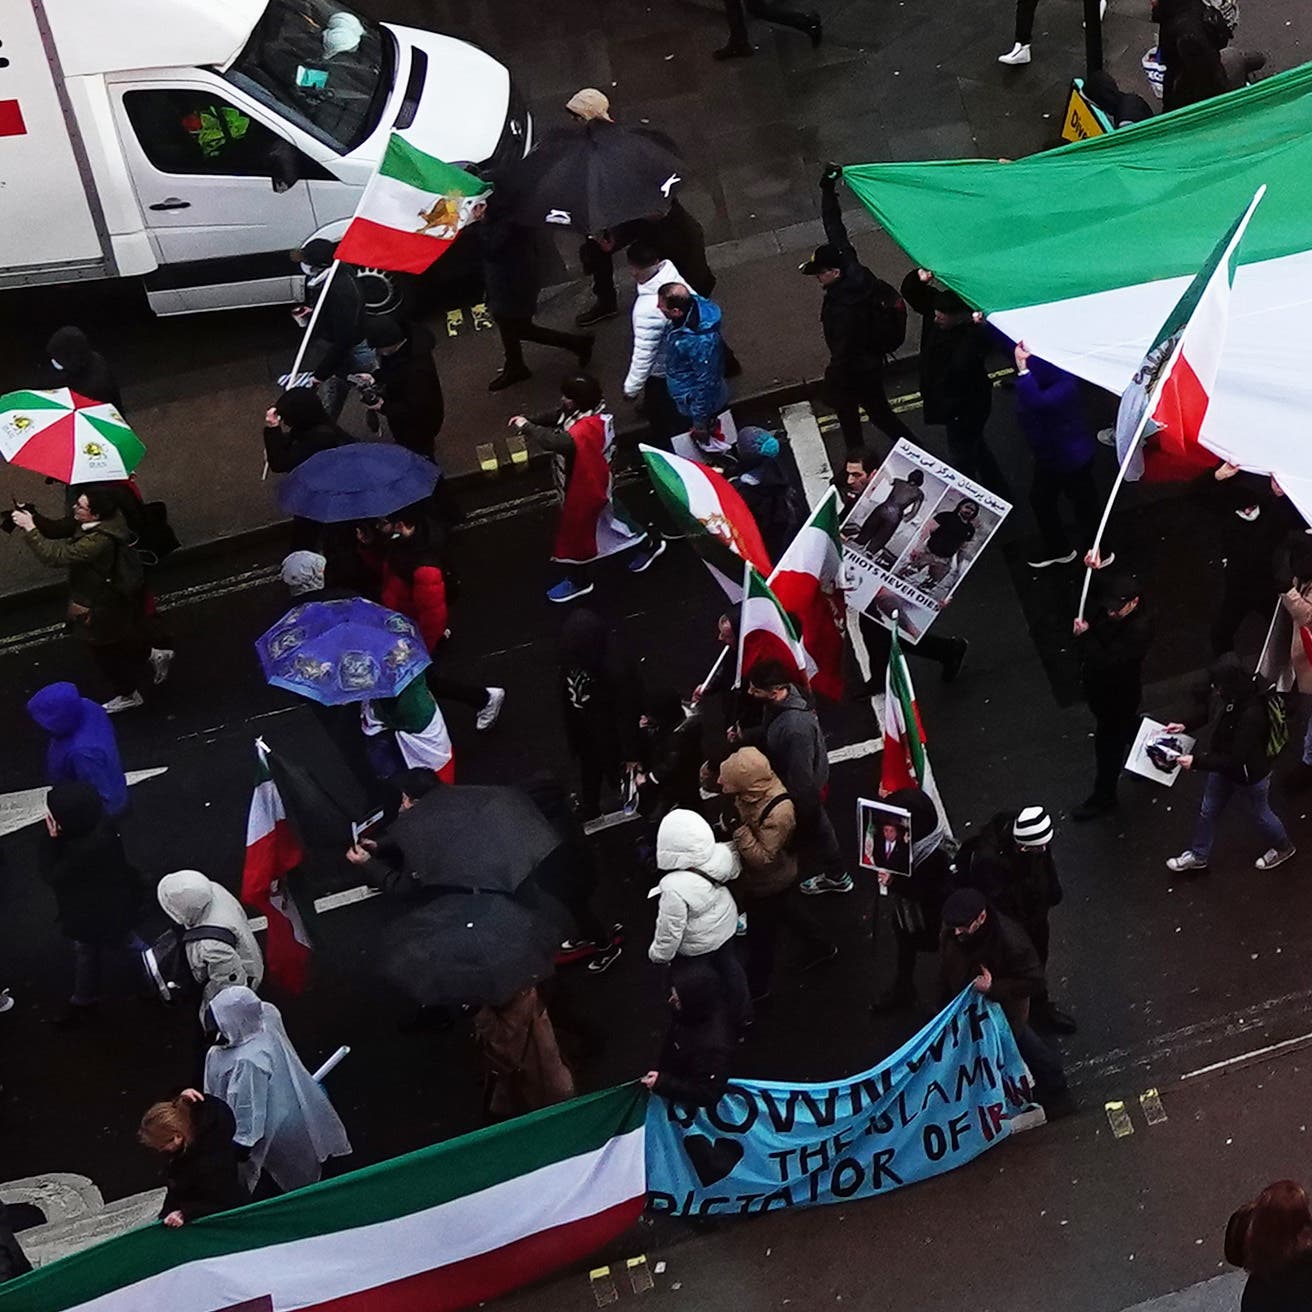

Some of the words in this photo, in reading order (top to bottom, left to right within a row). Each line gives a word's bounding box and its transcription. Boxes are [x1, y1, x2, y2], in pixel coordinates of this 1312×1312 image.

[843, 549, 880, 576] TRIOTS
[881, 571, 916, 599] NEVER
[769, 1126, 852, 1182] THE
[922, 1110, 972, 1162] OF
